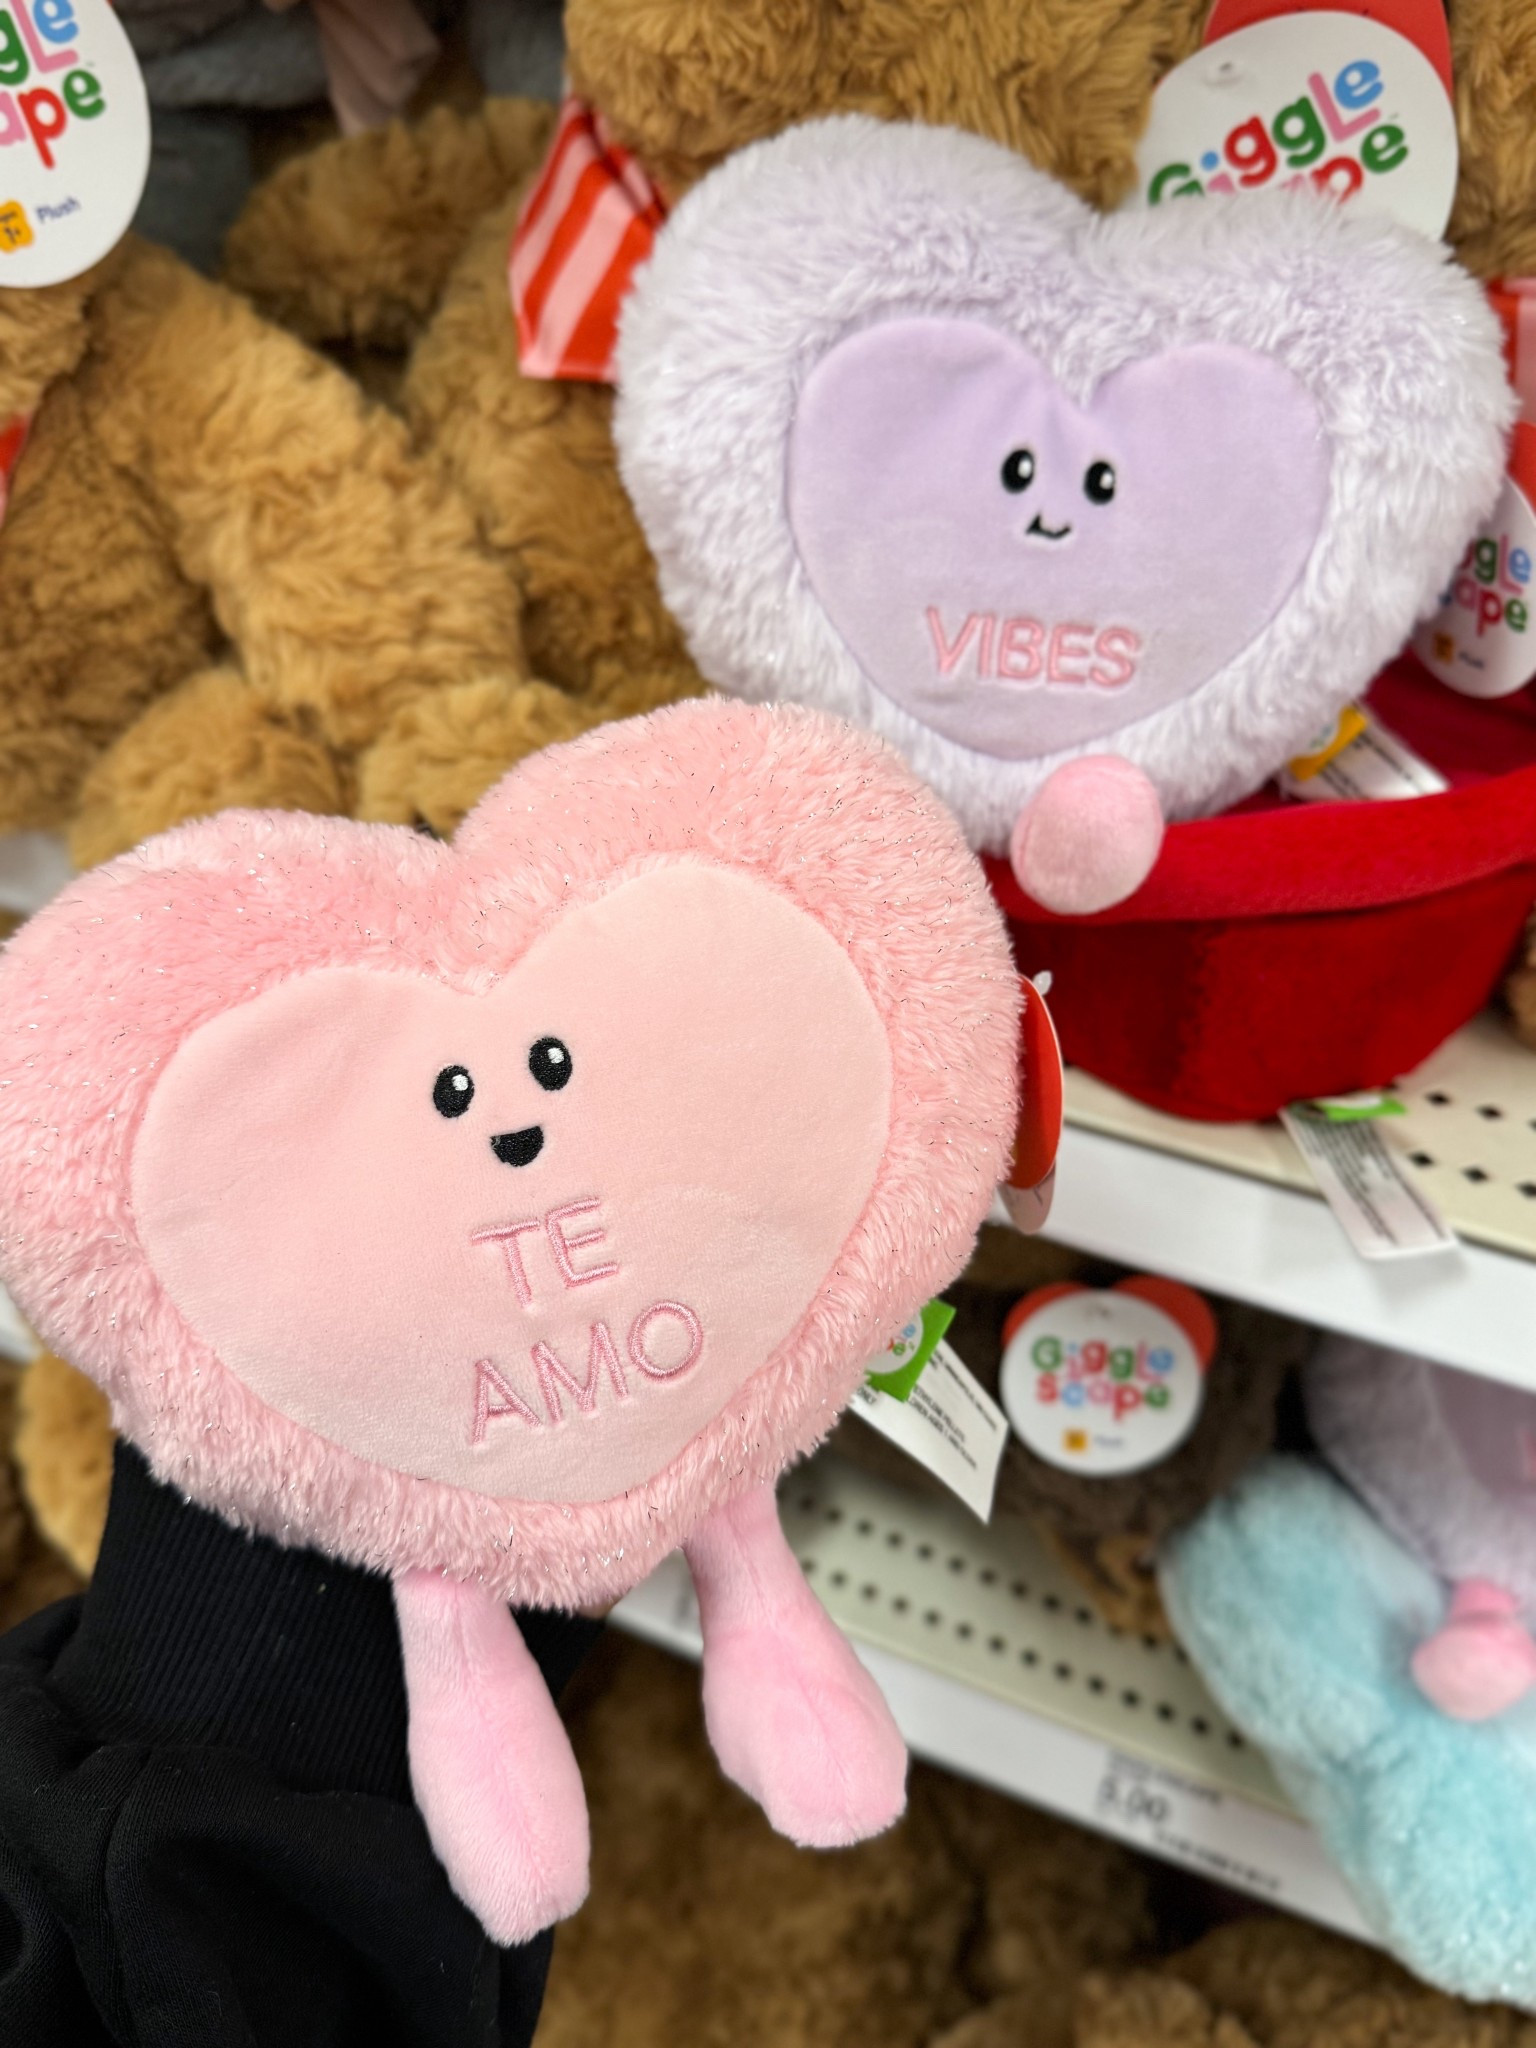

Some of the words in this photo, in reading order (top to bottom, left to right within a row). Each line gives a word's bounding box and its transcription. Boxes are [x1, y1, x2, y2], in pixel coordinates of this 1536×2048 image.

[926, 605, 1142, 689] VIBES
[471, 1196, 619, 1309] TE
[469, 1300, 703, 1445] AMO
